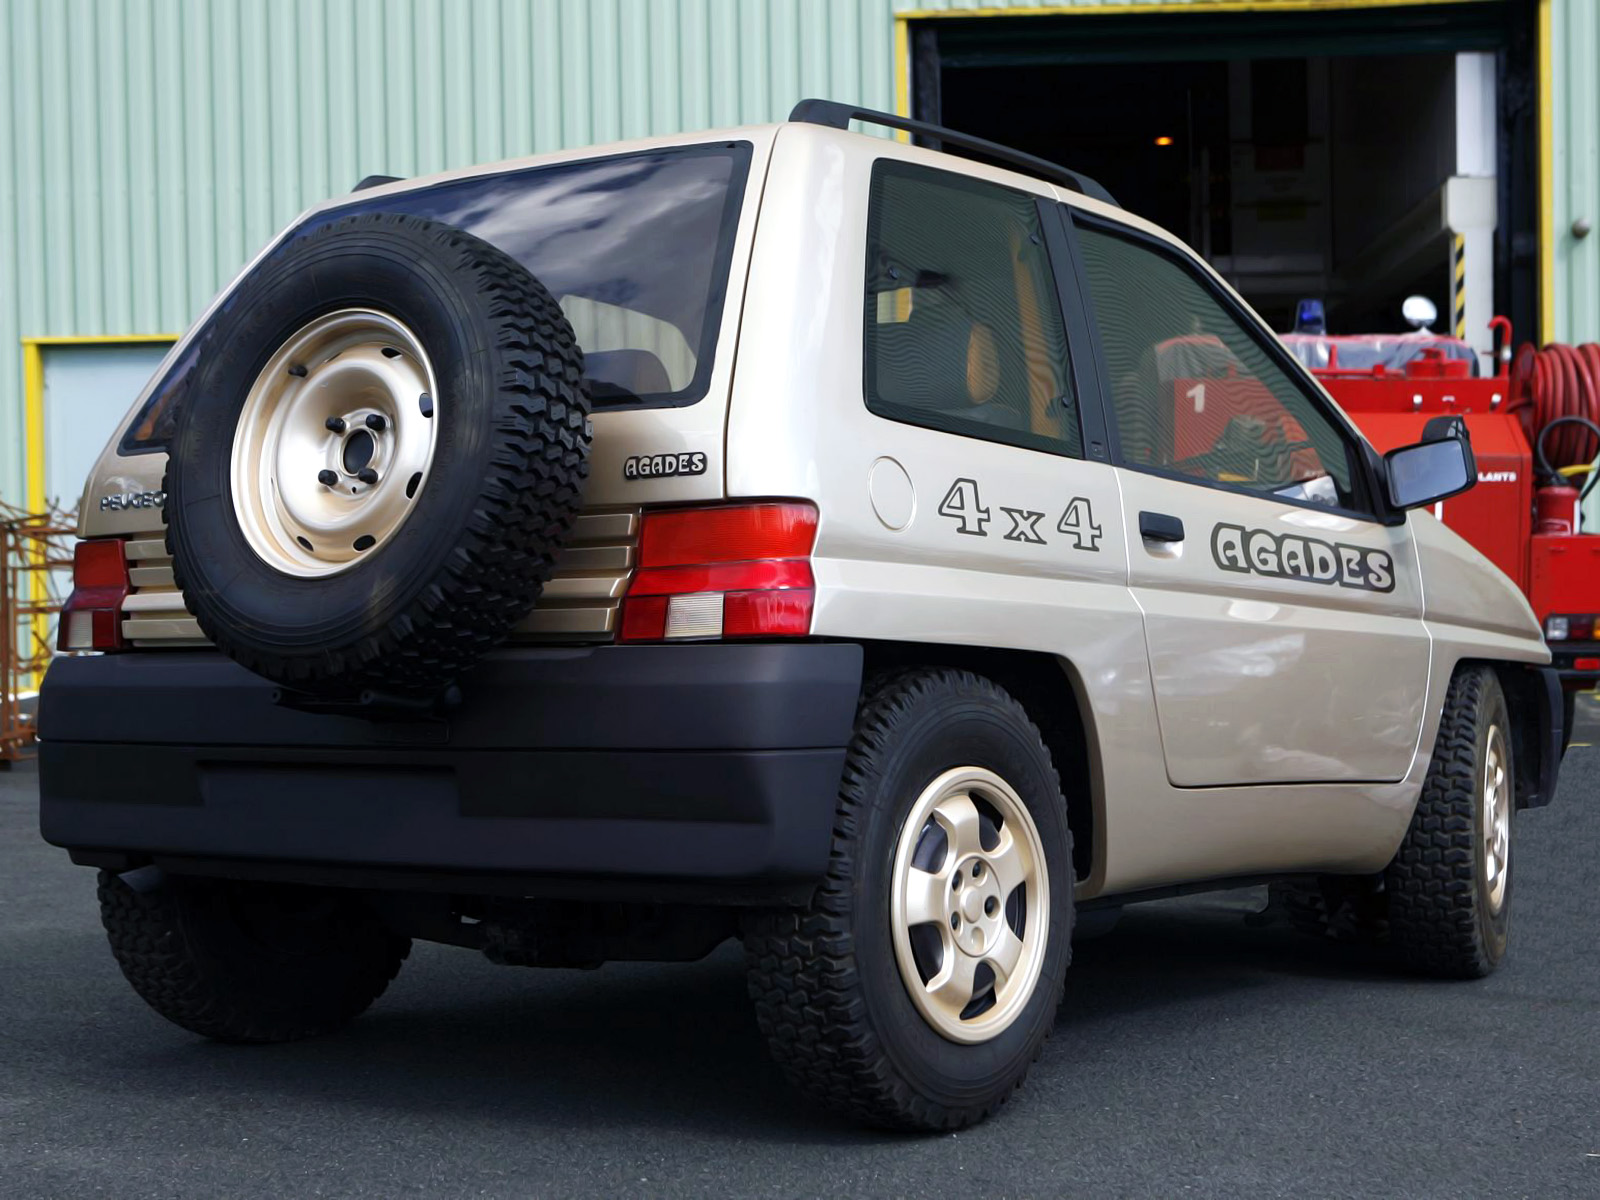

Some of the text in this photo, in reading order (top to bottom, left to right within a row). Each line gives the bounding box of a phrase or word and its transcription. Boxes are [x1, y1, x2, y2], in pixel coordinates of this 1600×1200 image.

[1186, 384, 1205, 413] 1
[625, 453, 706, 478] AGADES
[100, 490, 167, 511] PEUGEO
[1212, 523, 1395, 592] AGADES
